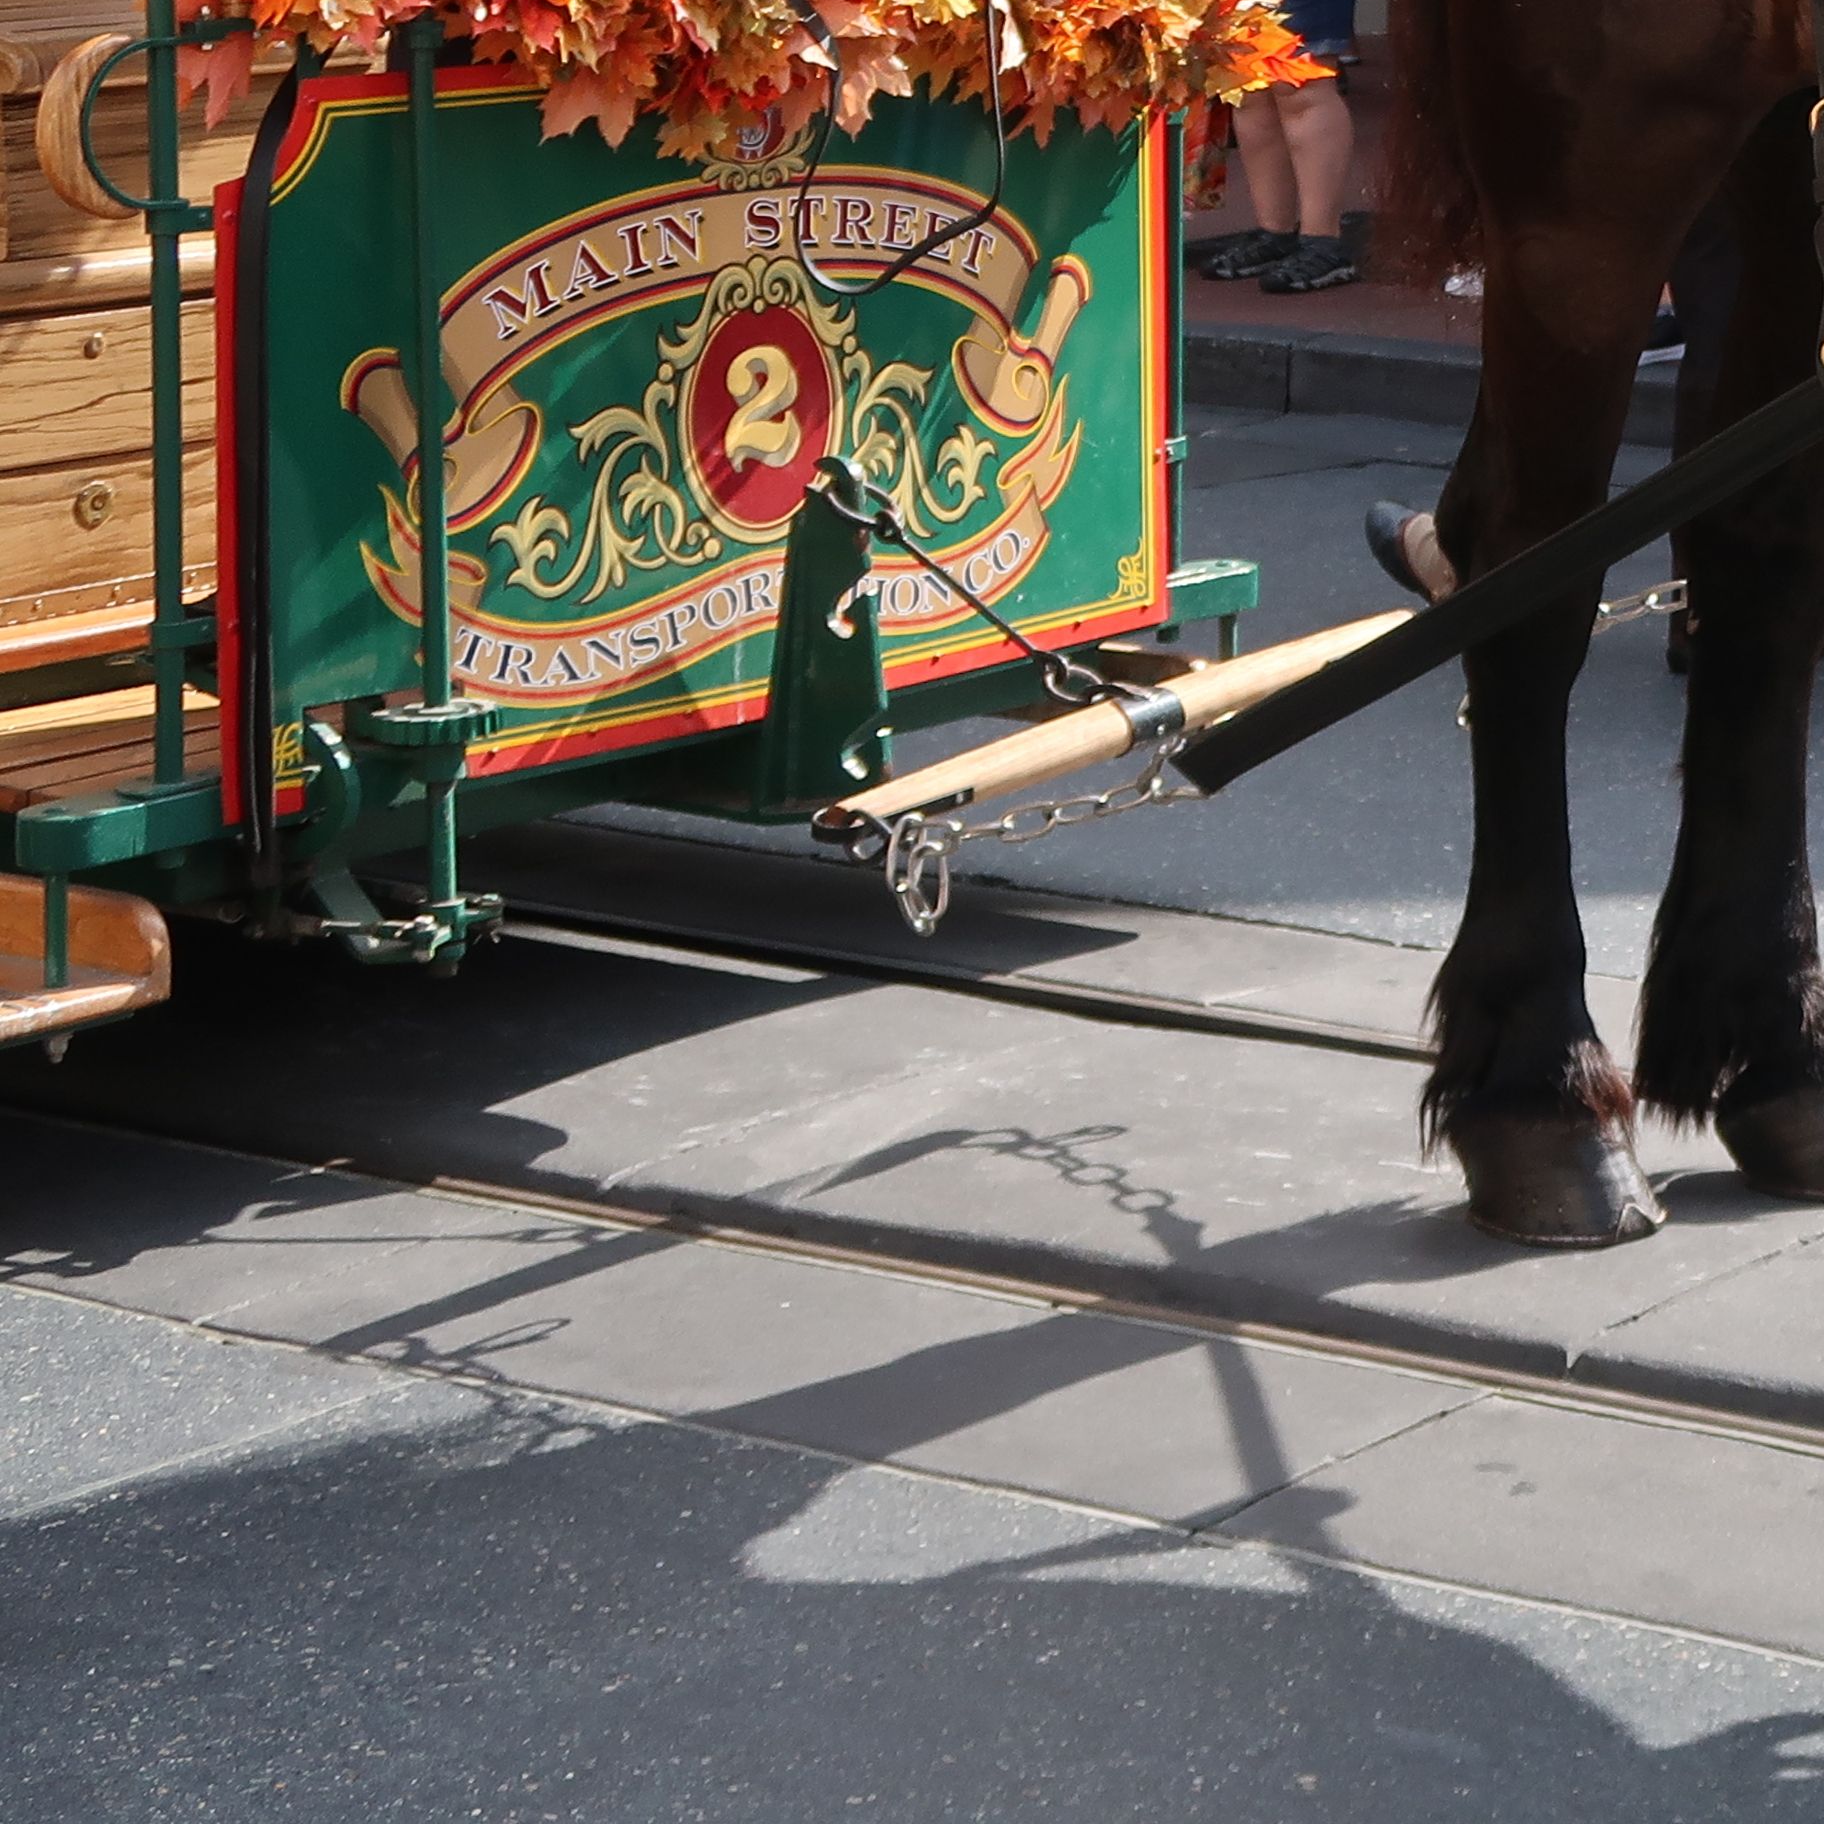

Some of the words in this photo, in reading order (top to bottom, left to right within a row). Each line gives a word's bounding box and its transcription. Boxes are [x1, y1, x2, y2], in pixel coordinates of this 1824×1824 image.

[482, 208, 704, 340] MAIN
[744, 194, 996, 276] STREET
[724, 344, 803, 472] 2
[453, 567, 956, 688] TRANSPORION
[963, 527, 1030, 597] CO.
